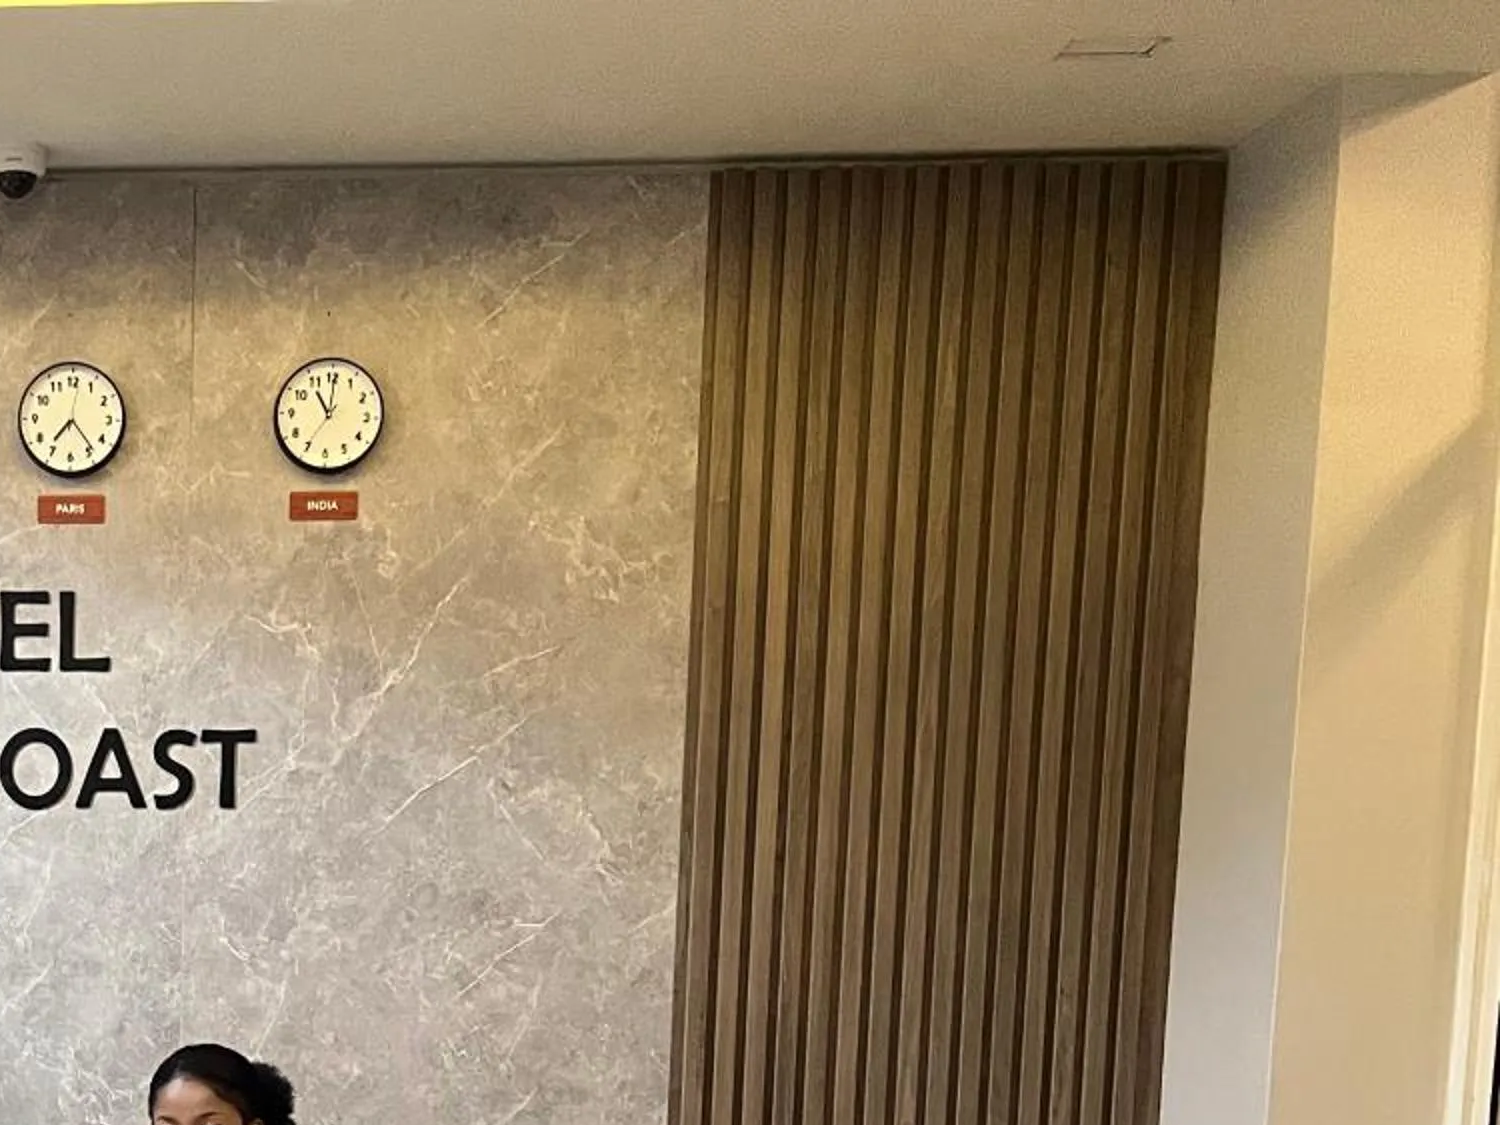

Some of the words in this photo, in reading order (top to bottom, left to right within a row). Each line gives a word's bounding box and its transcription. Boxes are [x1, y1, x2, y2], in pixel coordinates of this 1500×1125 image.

[68, 377, 79, 388] 12
[310, 376, 320, 387] 11
[327, 372, 338, 384] 12
[51, 381, 62, 392] 11
[100, 395, 107, 406] 2
[295, 390, 307, 400] 10
[359, 392, 366, 404] 2
[288, 408, 295, 418] 9
[32, 414, 38, 424] 9
[105, 415, 112, 426] 3
[98, 434, 104, 444] 4
[355, 431, 361, 440] 4
[50, 446, 56, 456] 7
[304, 440, 312, 452] 7
[341, 443, 347, 454] 5
[67, 452, 74, 462] 6
[322, 448, 328, 458] 6
[55, 503, 85, 514] PARIS
[307, 500, 339, 511] INDIA
